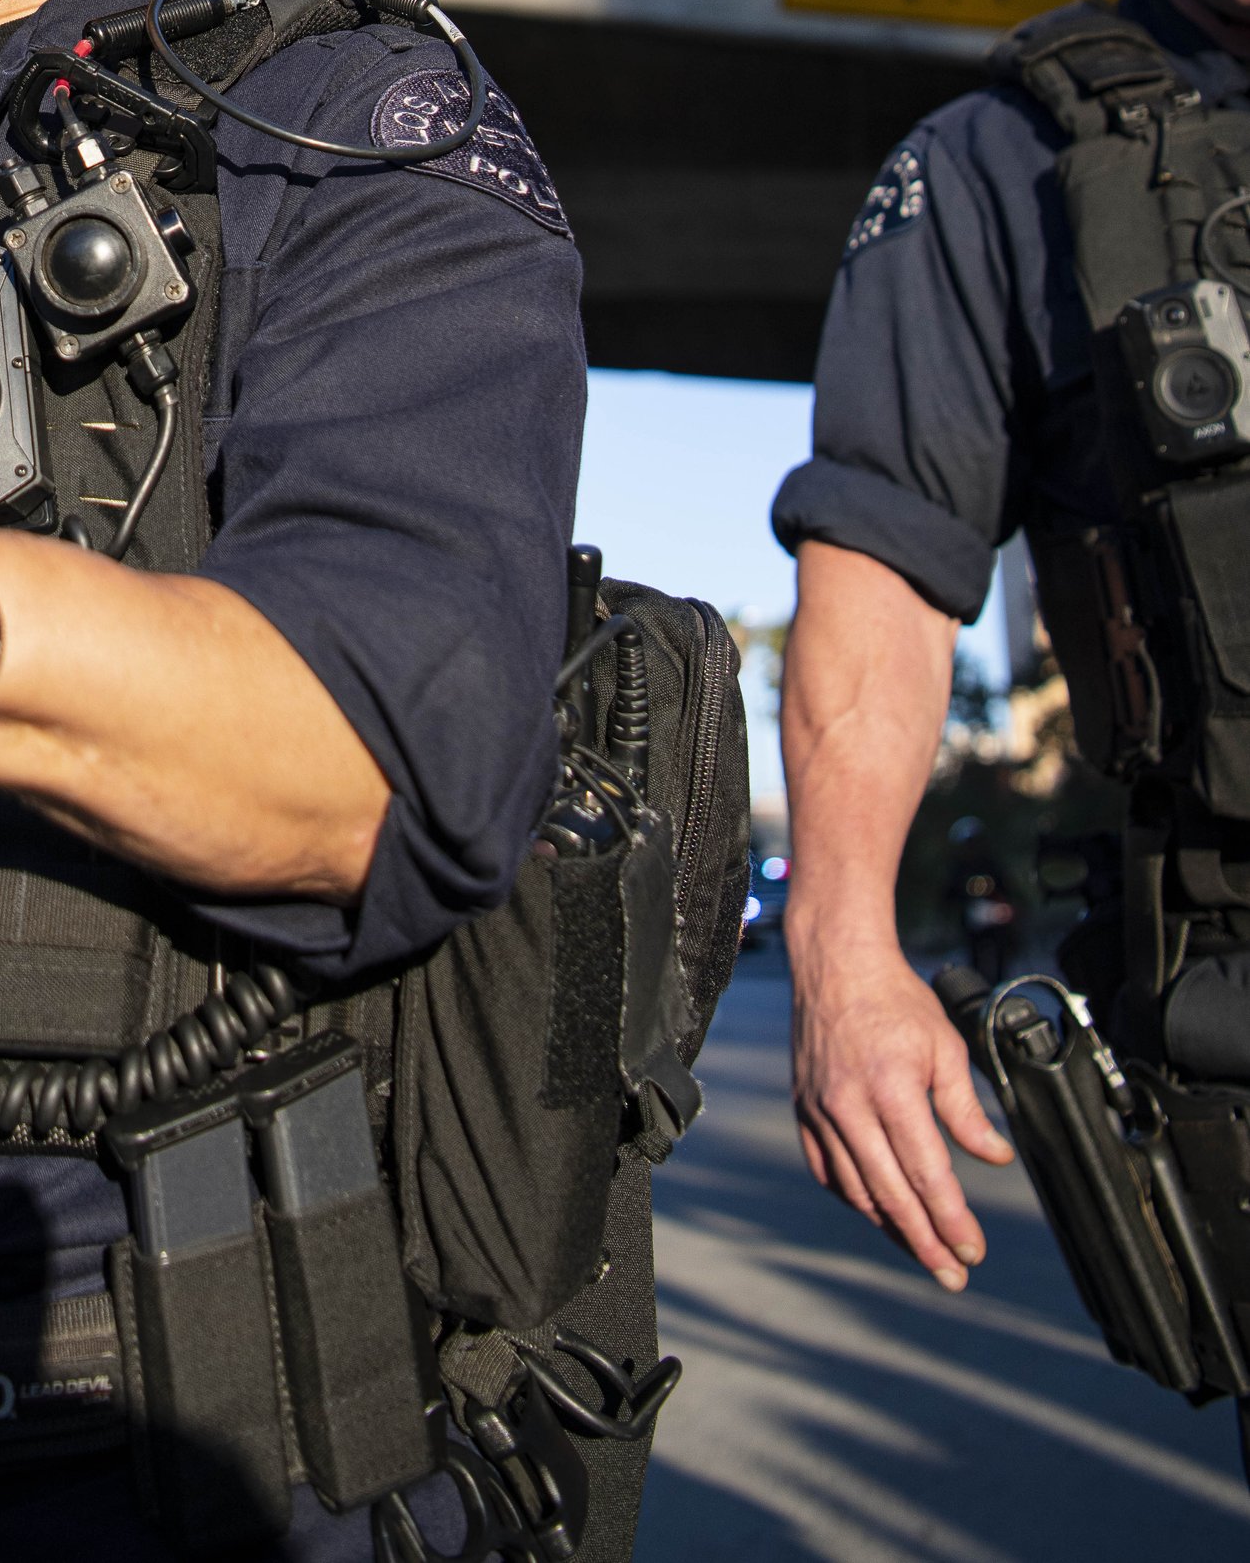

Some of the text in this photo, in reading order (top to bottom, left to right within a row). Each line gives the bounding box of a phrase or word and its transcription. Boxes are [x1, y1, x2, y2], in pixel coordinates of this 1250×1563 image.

[394, 95, 439, 145] LOS
[20, 1375, 113, 1398] LEAD DEVIL
